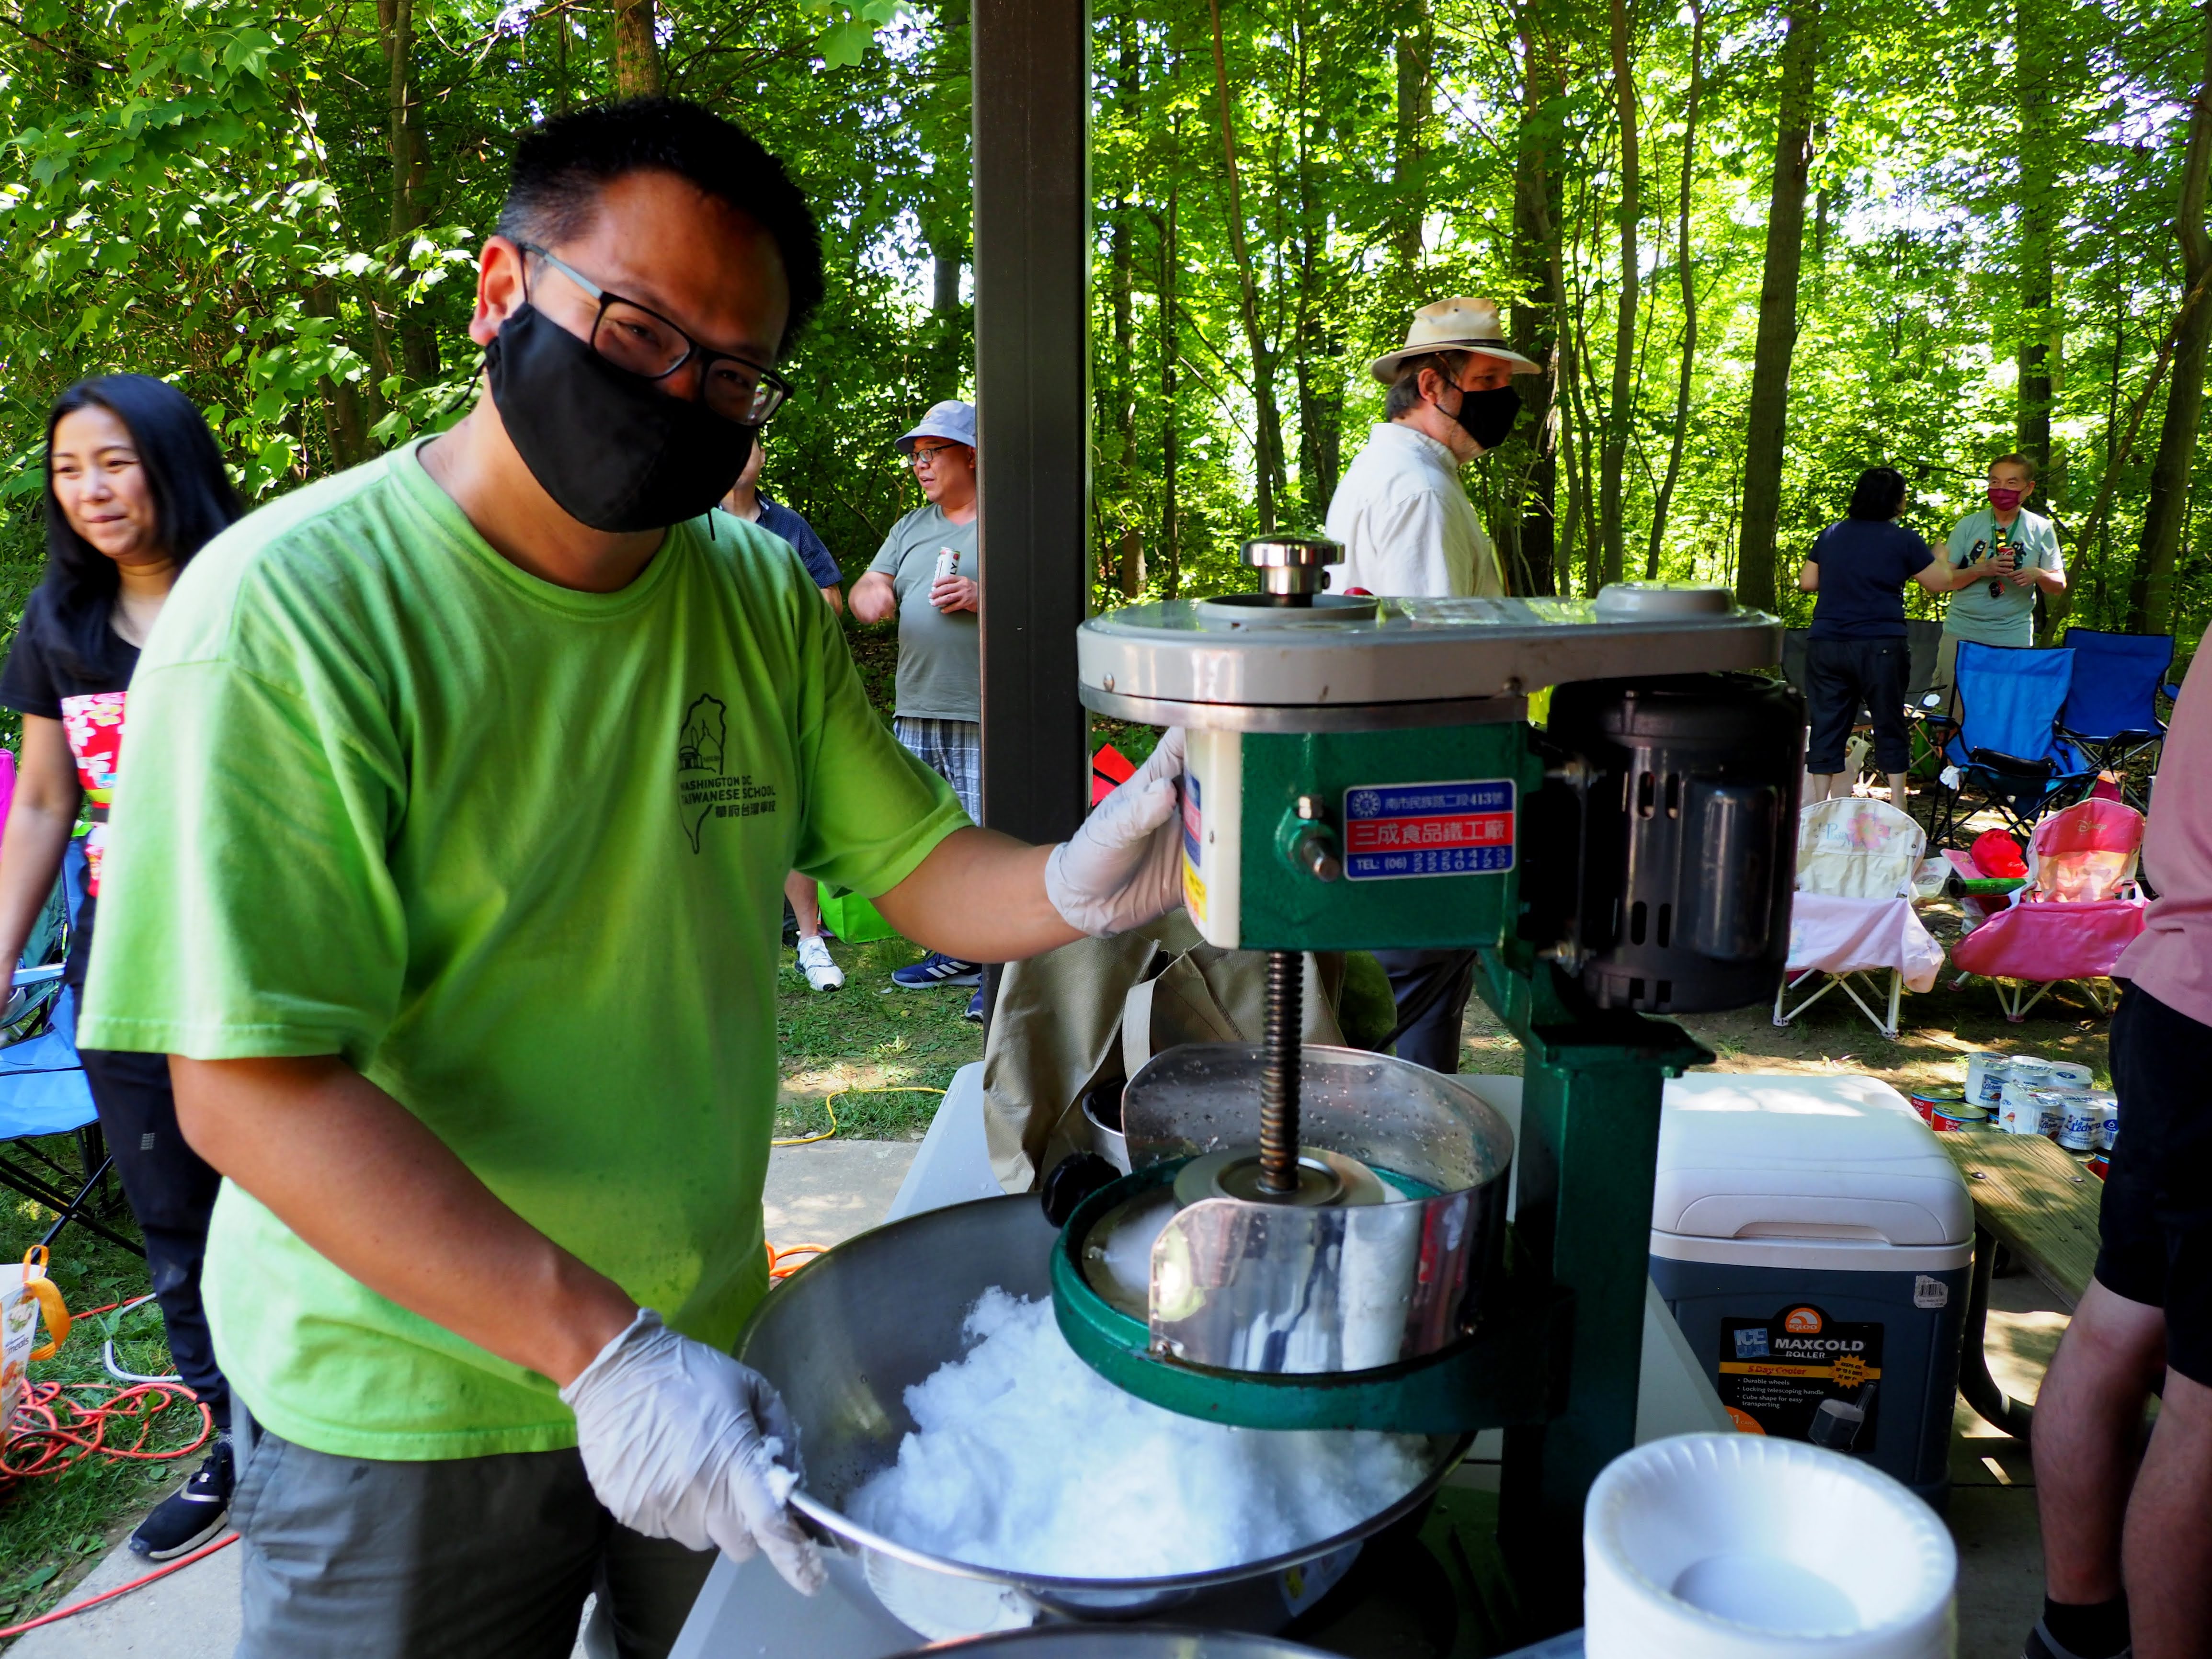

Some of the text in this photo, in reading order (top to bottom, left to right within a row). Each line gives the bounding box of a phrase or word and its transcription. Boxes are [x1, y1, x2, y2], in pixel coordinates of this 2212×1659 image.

[680, 775, 753, 791] WASHINGTON DC
[681, 785, 776, 804] TAIWANESE SCHOOL
[1355, 820, 1505, 846] 三成食品鐵工廠
[1356, 858, 1380, 870] TEL:
[1384, 857, 1407, 870] (06)
[1734, 1328, 1767, 1346] ICE
[1775, 1339, 1865, 1351] MAXCOLD
[1786, 1351, 1825, 1359] ROLLER
[1755, 1365, 1773, 1375] Day
[1775, 1366, 1807, 1375] Cooler
[1767, 1387, 1802, 1395] telescoping
[1742, 1401, 1780, 1409] transporting
